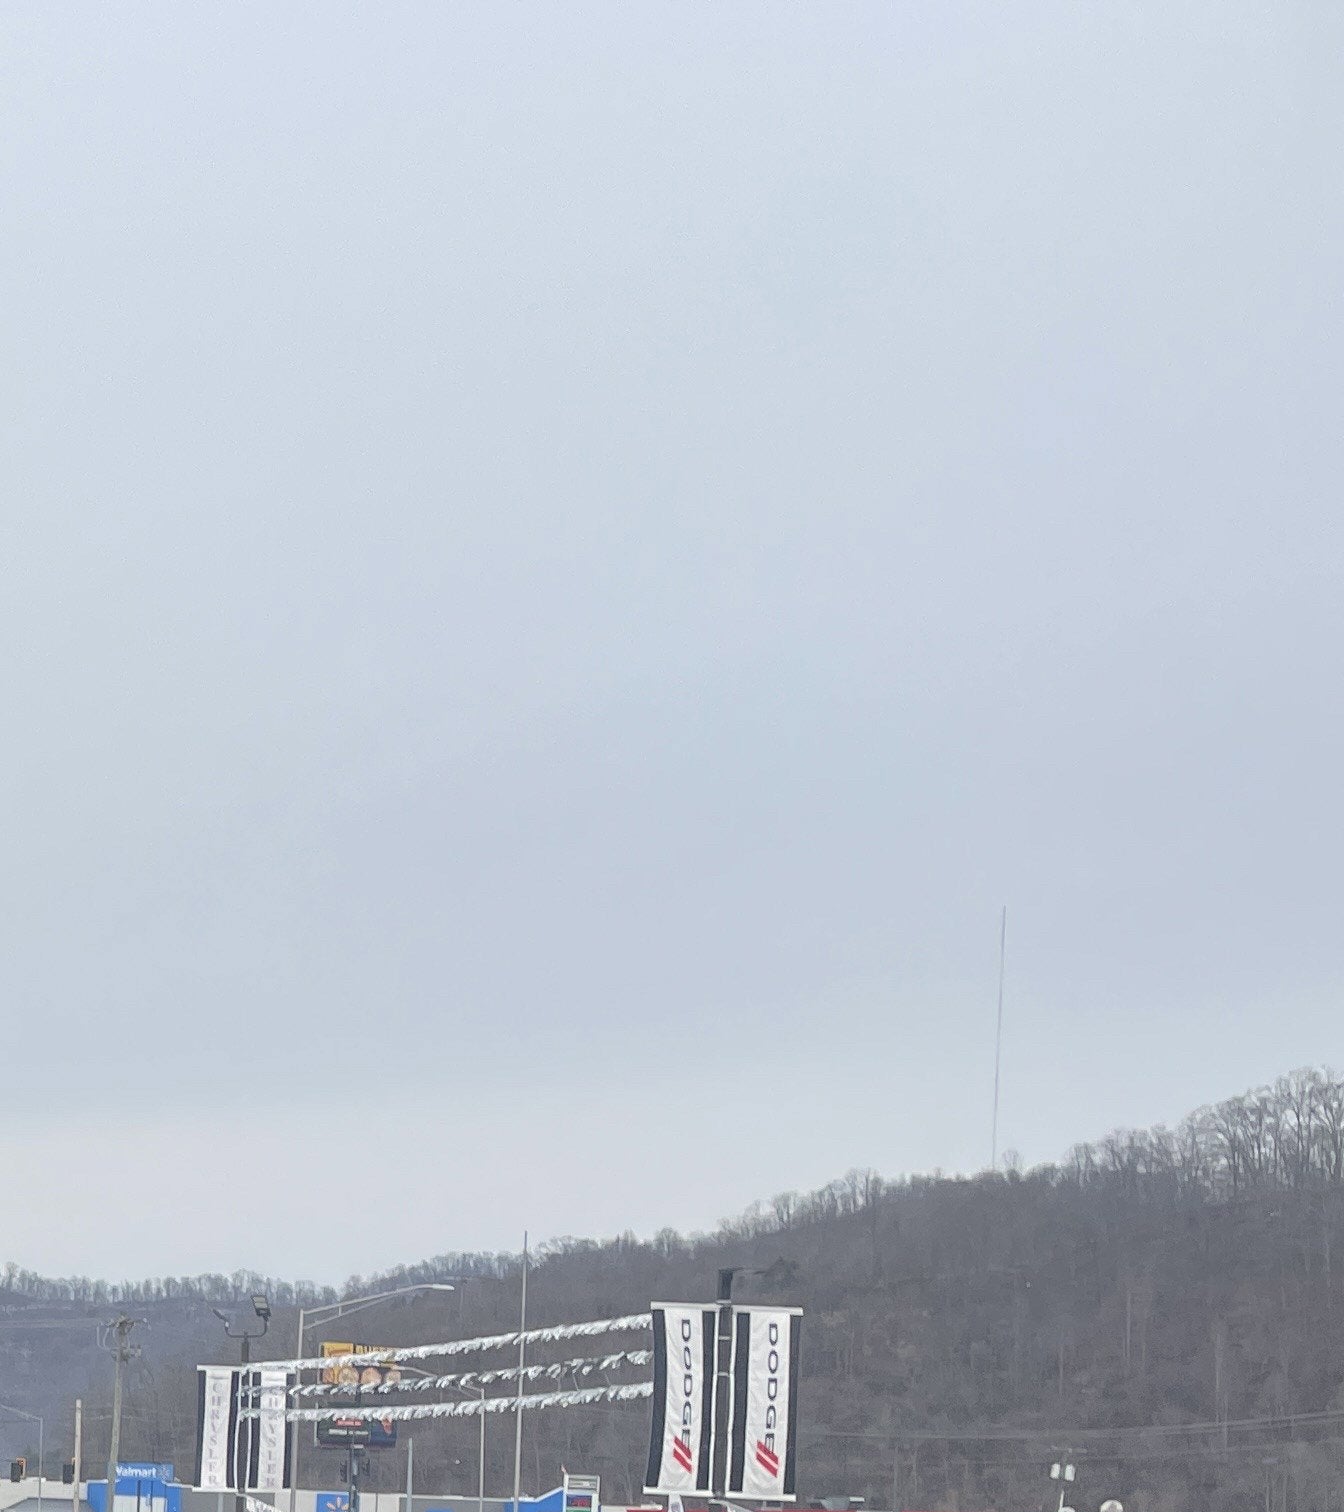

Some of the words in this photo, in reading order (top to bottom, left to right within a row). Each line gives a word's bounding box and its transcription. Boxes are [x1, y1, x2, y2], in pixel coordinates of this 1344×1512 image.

[207, 1382, 223, 1486] CHRYSLER
[265, 1386, 280, 1487] HRYSLER
[681, 1319, 693, 1450] DODGE
[765, 1323, 779, 1455] DODGE
